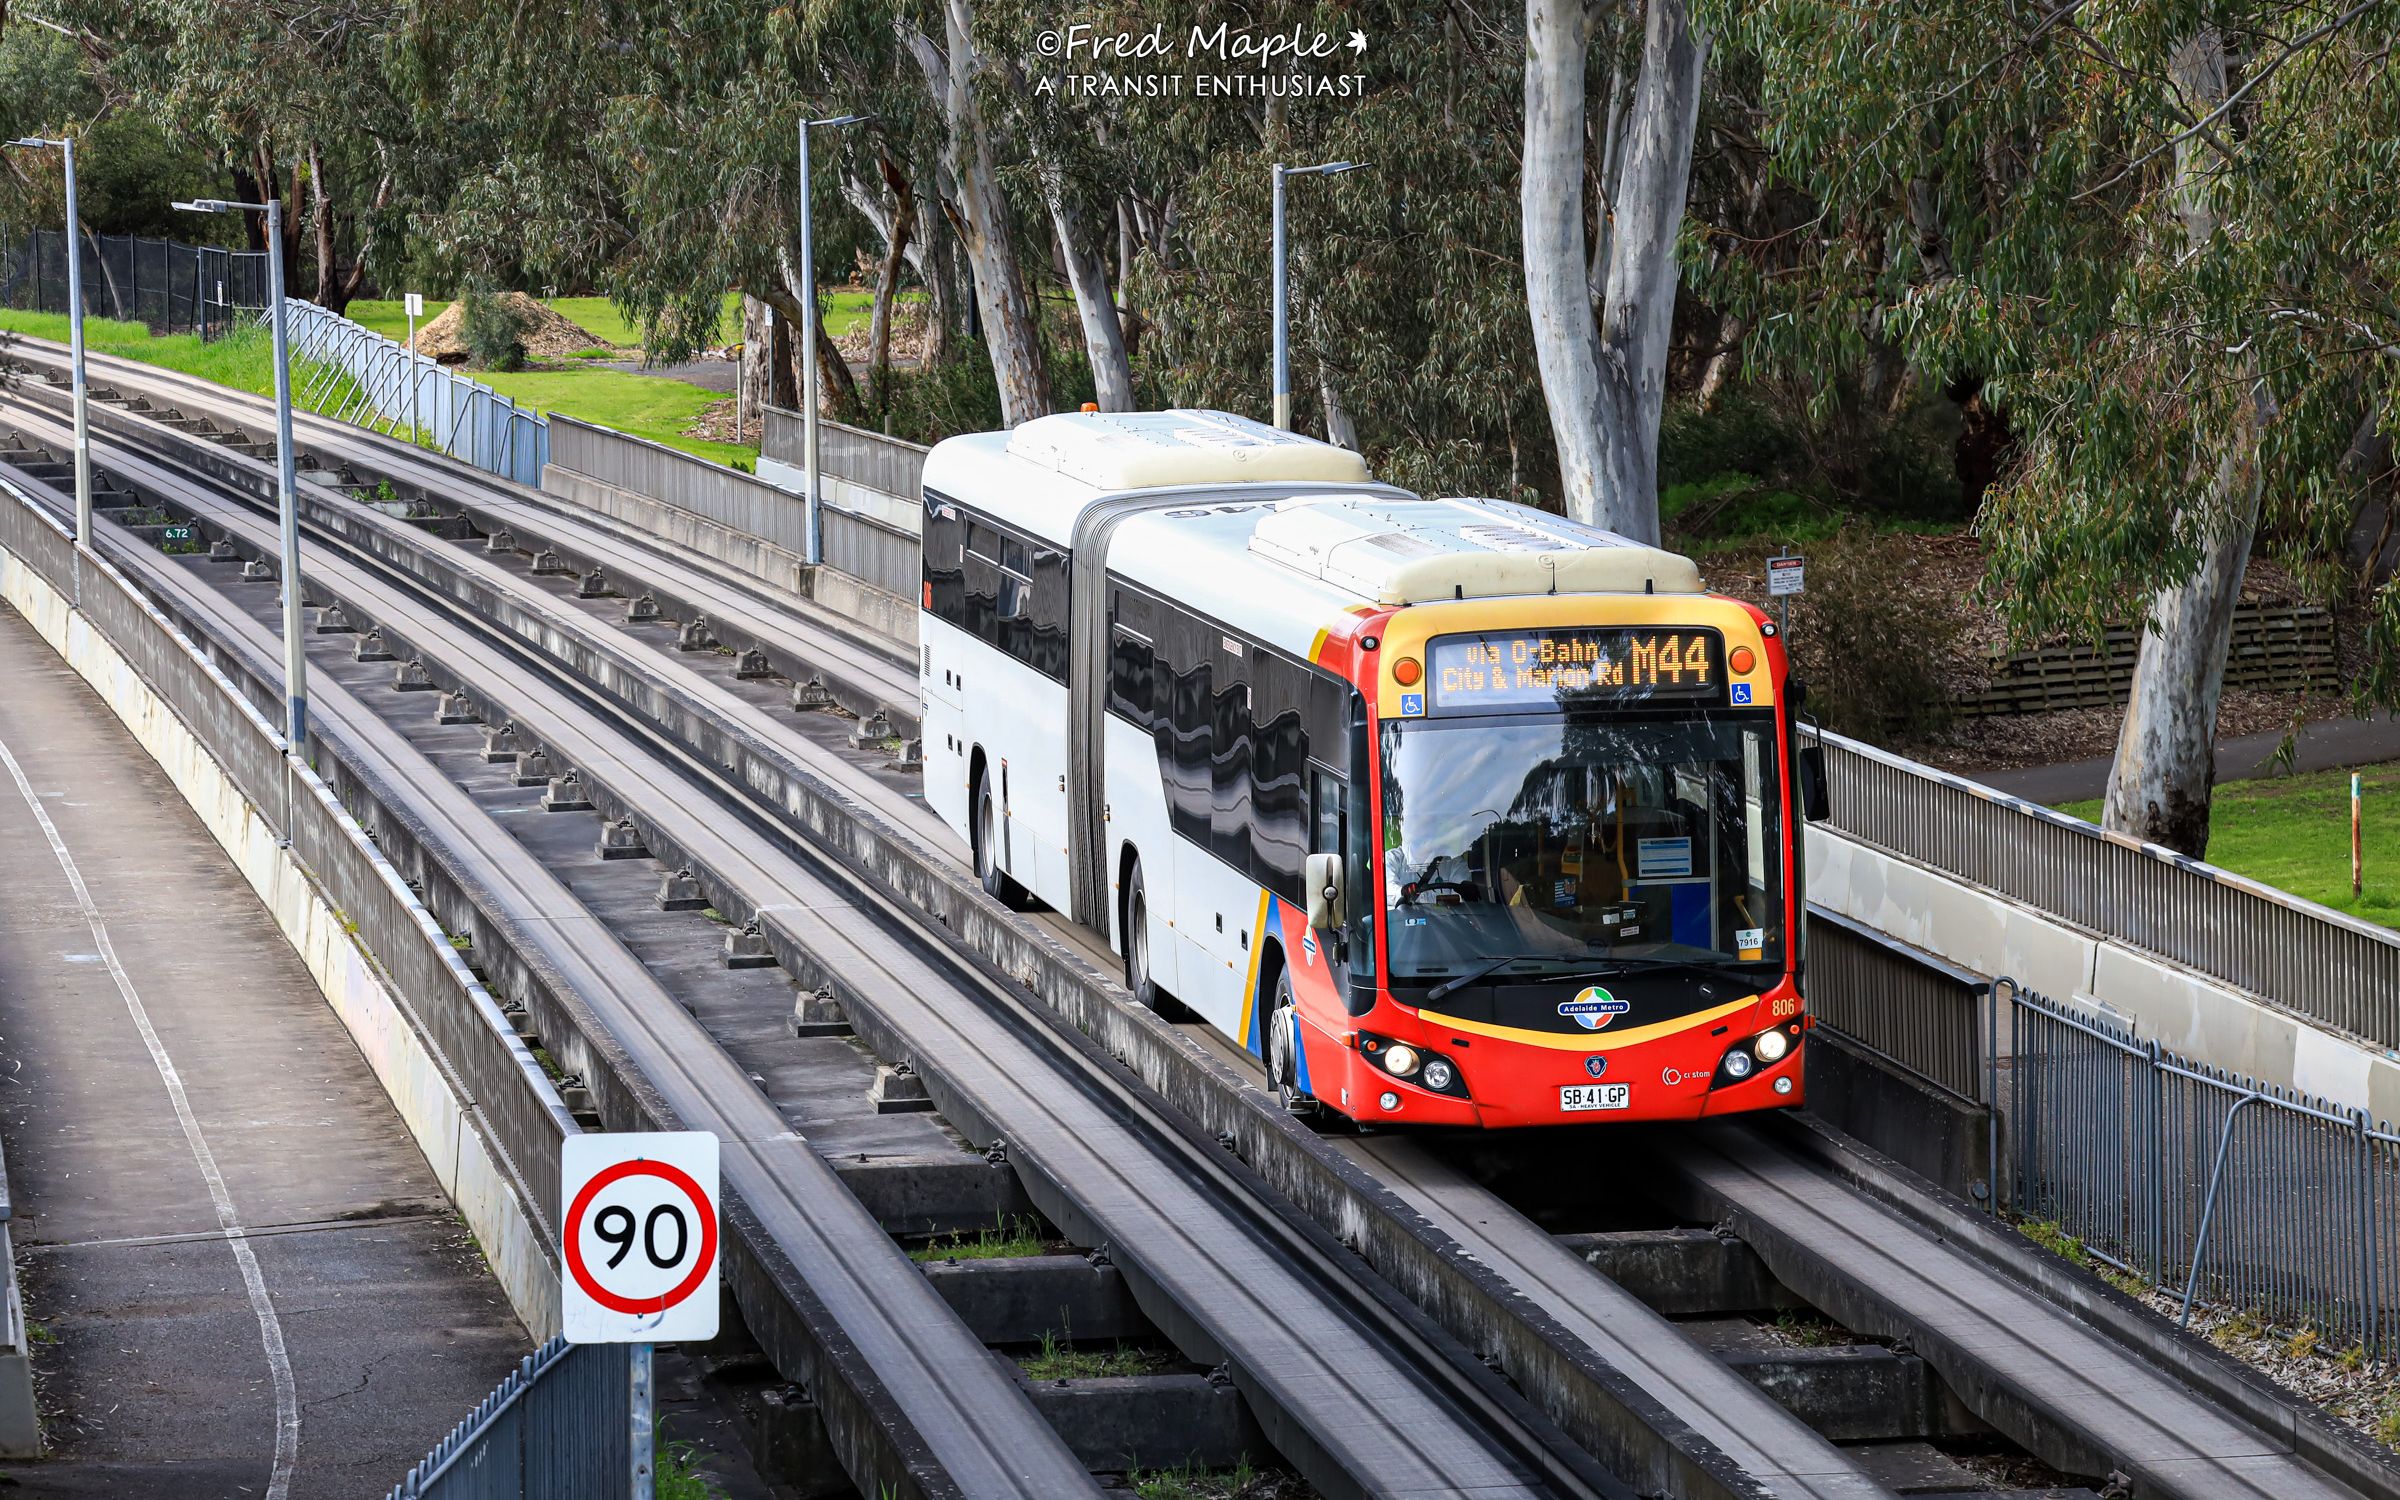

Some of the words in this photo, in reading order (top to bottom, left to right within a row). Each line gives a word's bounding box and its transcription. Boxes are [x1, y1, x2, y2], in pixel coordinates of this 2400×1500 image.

[165, 528, 189, 538] 6.72
[1467, 641, 1500, 664] via
[1512, 638, 1599, 664] O-Bahn
[1632, 635, 1709, 684] M44
[1443, 667, 1484, 691] City
[1492, 666, 1509, 689] &
[1516, 665, 1590, 688] Marion
[1597, 662, 1624, 686] Rd
[1739, 938, 1759, 947] 7916
[1772, 998, 1795, 1017] 806
[594, 1204, 688, 1270] 90
